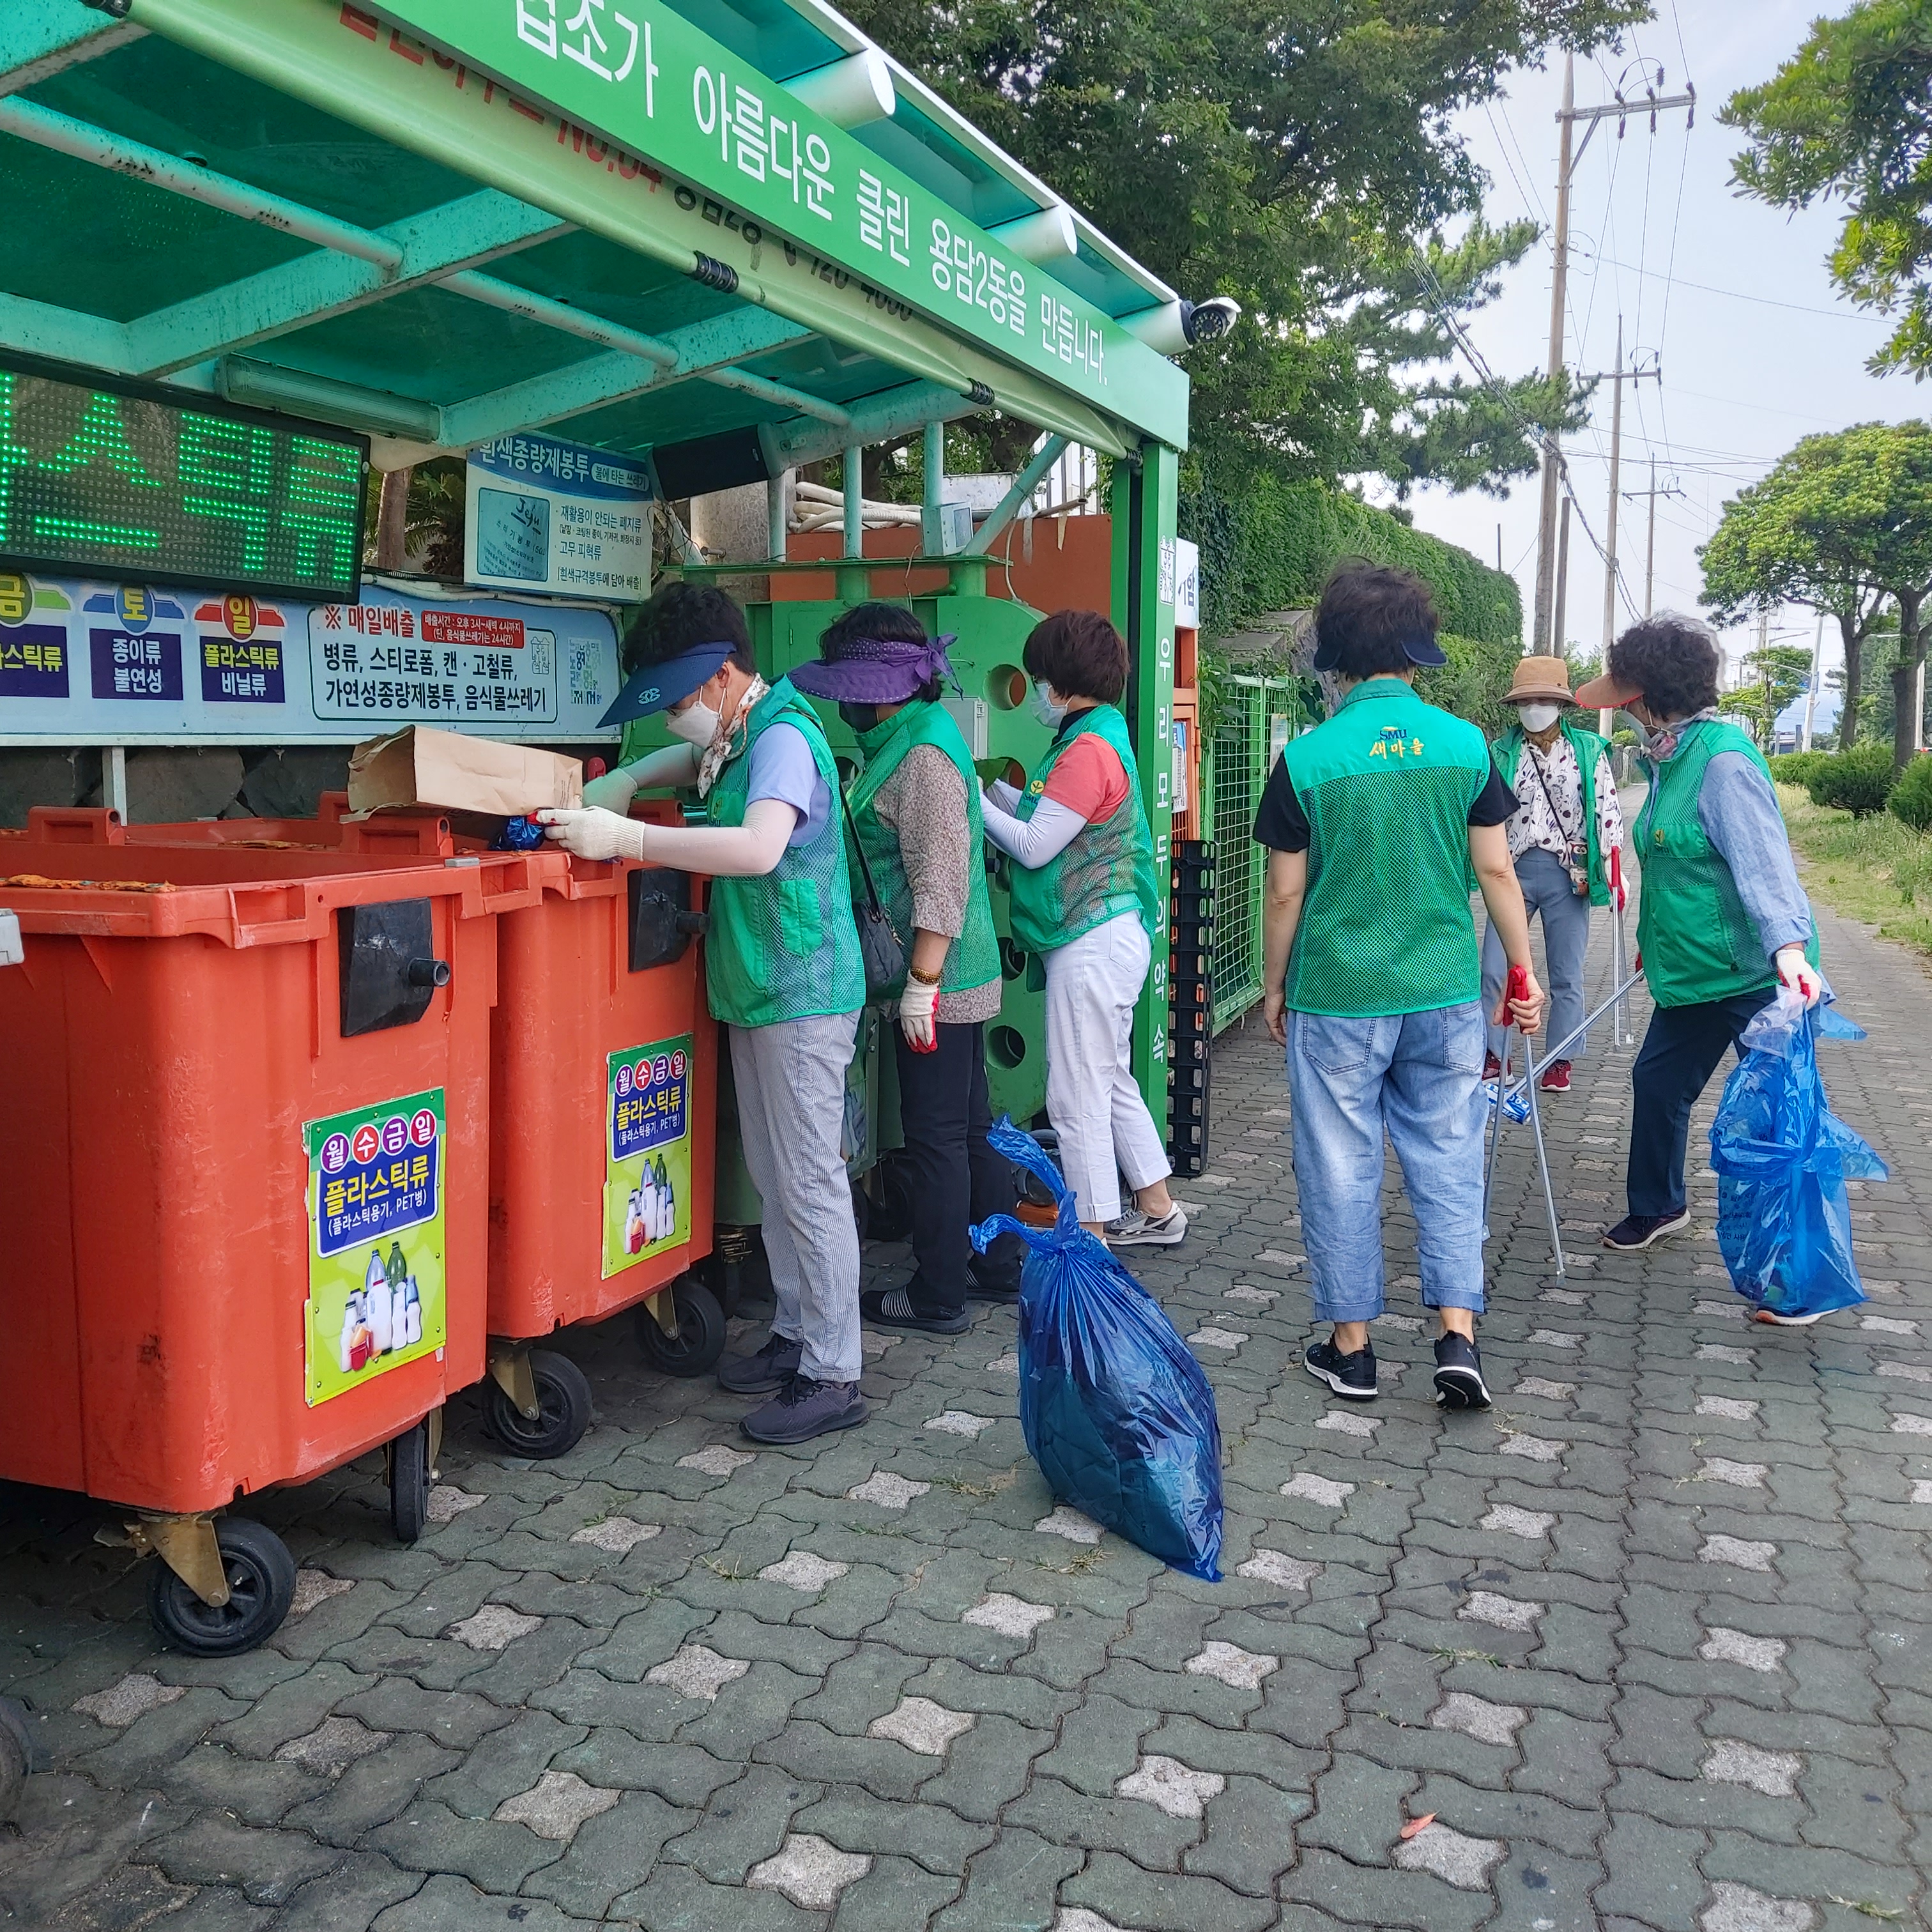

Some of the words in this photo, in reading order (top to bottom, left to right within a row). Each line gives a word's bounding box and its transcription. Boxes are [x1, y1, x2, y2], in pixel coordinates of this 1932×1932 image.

[693, 65, 834, 220] 아름다운
[857, 168, 910, 267] 클린
[929, 218, 1027, 337] 용담2동을
[1041, 293, 1108, 386] 만듭니다.
[595, 466, 609, 482] 불에
[611, 468, 624, 484] 타는
[626, 473, 646, 491] 쓰레기
[561, 505, 592, 525] 재활용이
[595, 512, 617, 529] 안되는
[620, 516, 641, 533] 폐지류
[560, 540, 576, 557] 고무
[578, 542, 601, 561] 피혁류
[0, 575, 25, 618] 금
[611, 573, 624, 588] 담아
[122, 587, 148, 621] 토
[229, 597, 251, 634] 일
[348, 606, 415, 638] 매일배출
[424, 613, 451, 627] 배출시간
[456, 618, 469, 629] 오후
[499, 621, 521, 634] 4시까지
[447, 629, 490, 643] 음식물쓰레기는
[492, 634, 514, 645] 24시간)
[112, 638, 162, 665] 종이류
[204, 644, 279, 670] 플라스틱류
[324, 643, 363, 673] 병류,
[370, 647, 438, 677] 스티로폼,
[443, 651, 457, 677] 캔
[473, 654, 517, 681] 고철류,
[114, 667, 162, 694] 불연성
[222, 672, 266, 696] 비닐류
[326, 678, 460, 711] 가연성종량제봉투,
[464, 685, 546, 712] 음식물쓰레기
[1159, 637, 1172, 747] 우리
[1369, 737, 1425, 760] 새마을
[1379, 728, 1407, 740] SMU
[1152, 959, 1166, 1064] 약속
[618, 1069, 630, 1094] 월
[637, 1065, 649, 1085] 수
[656, 1059, 666, 1080] 금
[674, 1054, 684, 1075] 일
[617, 1085, 682, 1131] 플라스틱류
[326, 1138, 344, 1169] 월
[357, 1131, 375, 1158] 수
[387, 1123, 404, 1151] 금
[415, 1114, 431, 1142] 일
[618, 1121, 659, 1146] (플라스틱용기,
[661, 1113, 680, 1130] PET병)
[324, 1154, 429, 1218] 플라스틱류
[328, 1201, 393, 1237] (플라스틱용기,
[396, 1188, 426, 1213] PET병)
